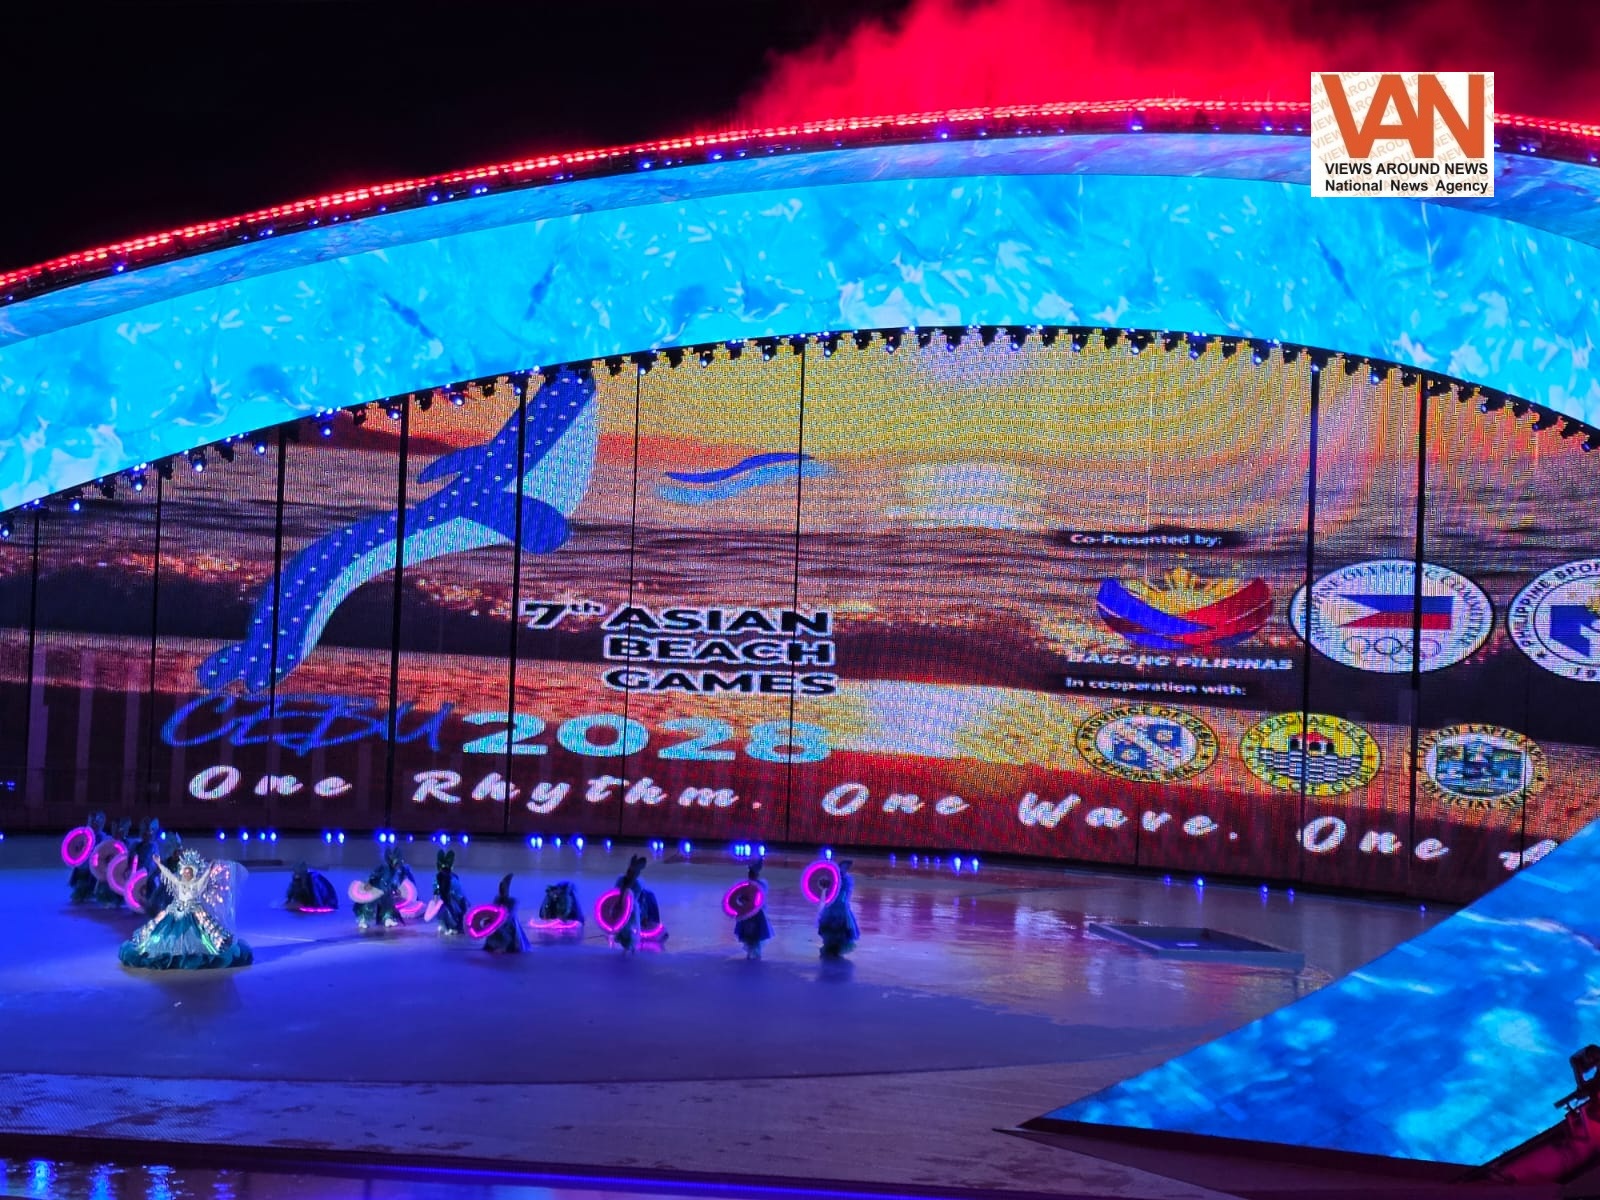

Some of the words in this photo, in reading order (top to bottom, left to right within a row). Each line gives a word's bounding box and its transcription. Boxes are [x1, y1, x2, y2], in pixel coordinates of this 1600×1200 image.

[1070, 534, 1190, 546] Co-Presented
[521, 601, 606, 629] 7th
[603, 605, 831, 636] ASIAN
[604, 636, 834, 665] BEACH
[604, 668, 838, 695] GAMES
[1066, 677, 1084, 688] In
[1088, 679, 1198, 693] cooperation
[462, 710, 834, 763] 2028
[189, 765, 353, 801] One
[411, 769, 762, 814] Rhythm.
[822, 783, 970, 817] One
[1017, 792, 1239, 839] Wave.
[1296, 816, 1450, 861] One
